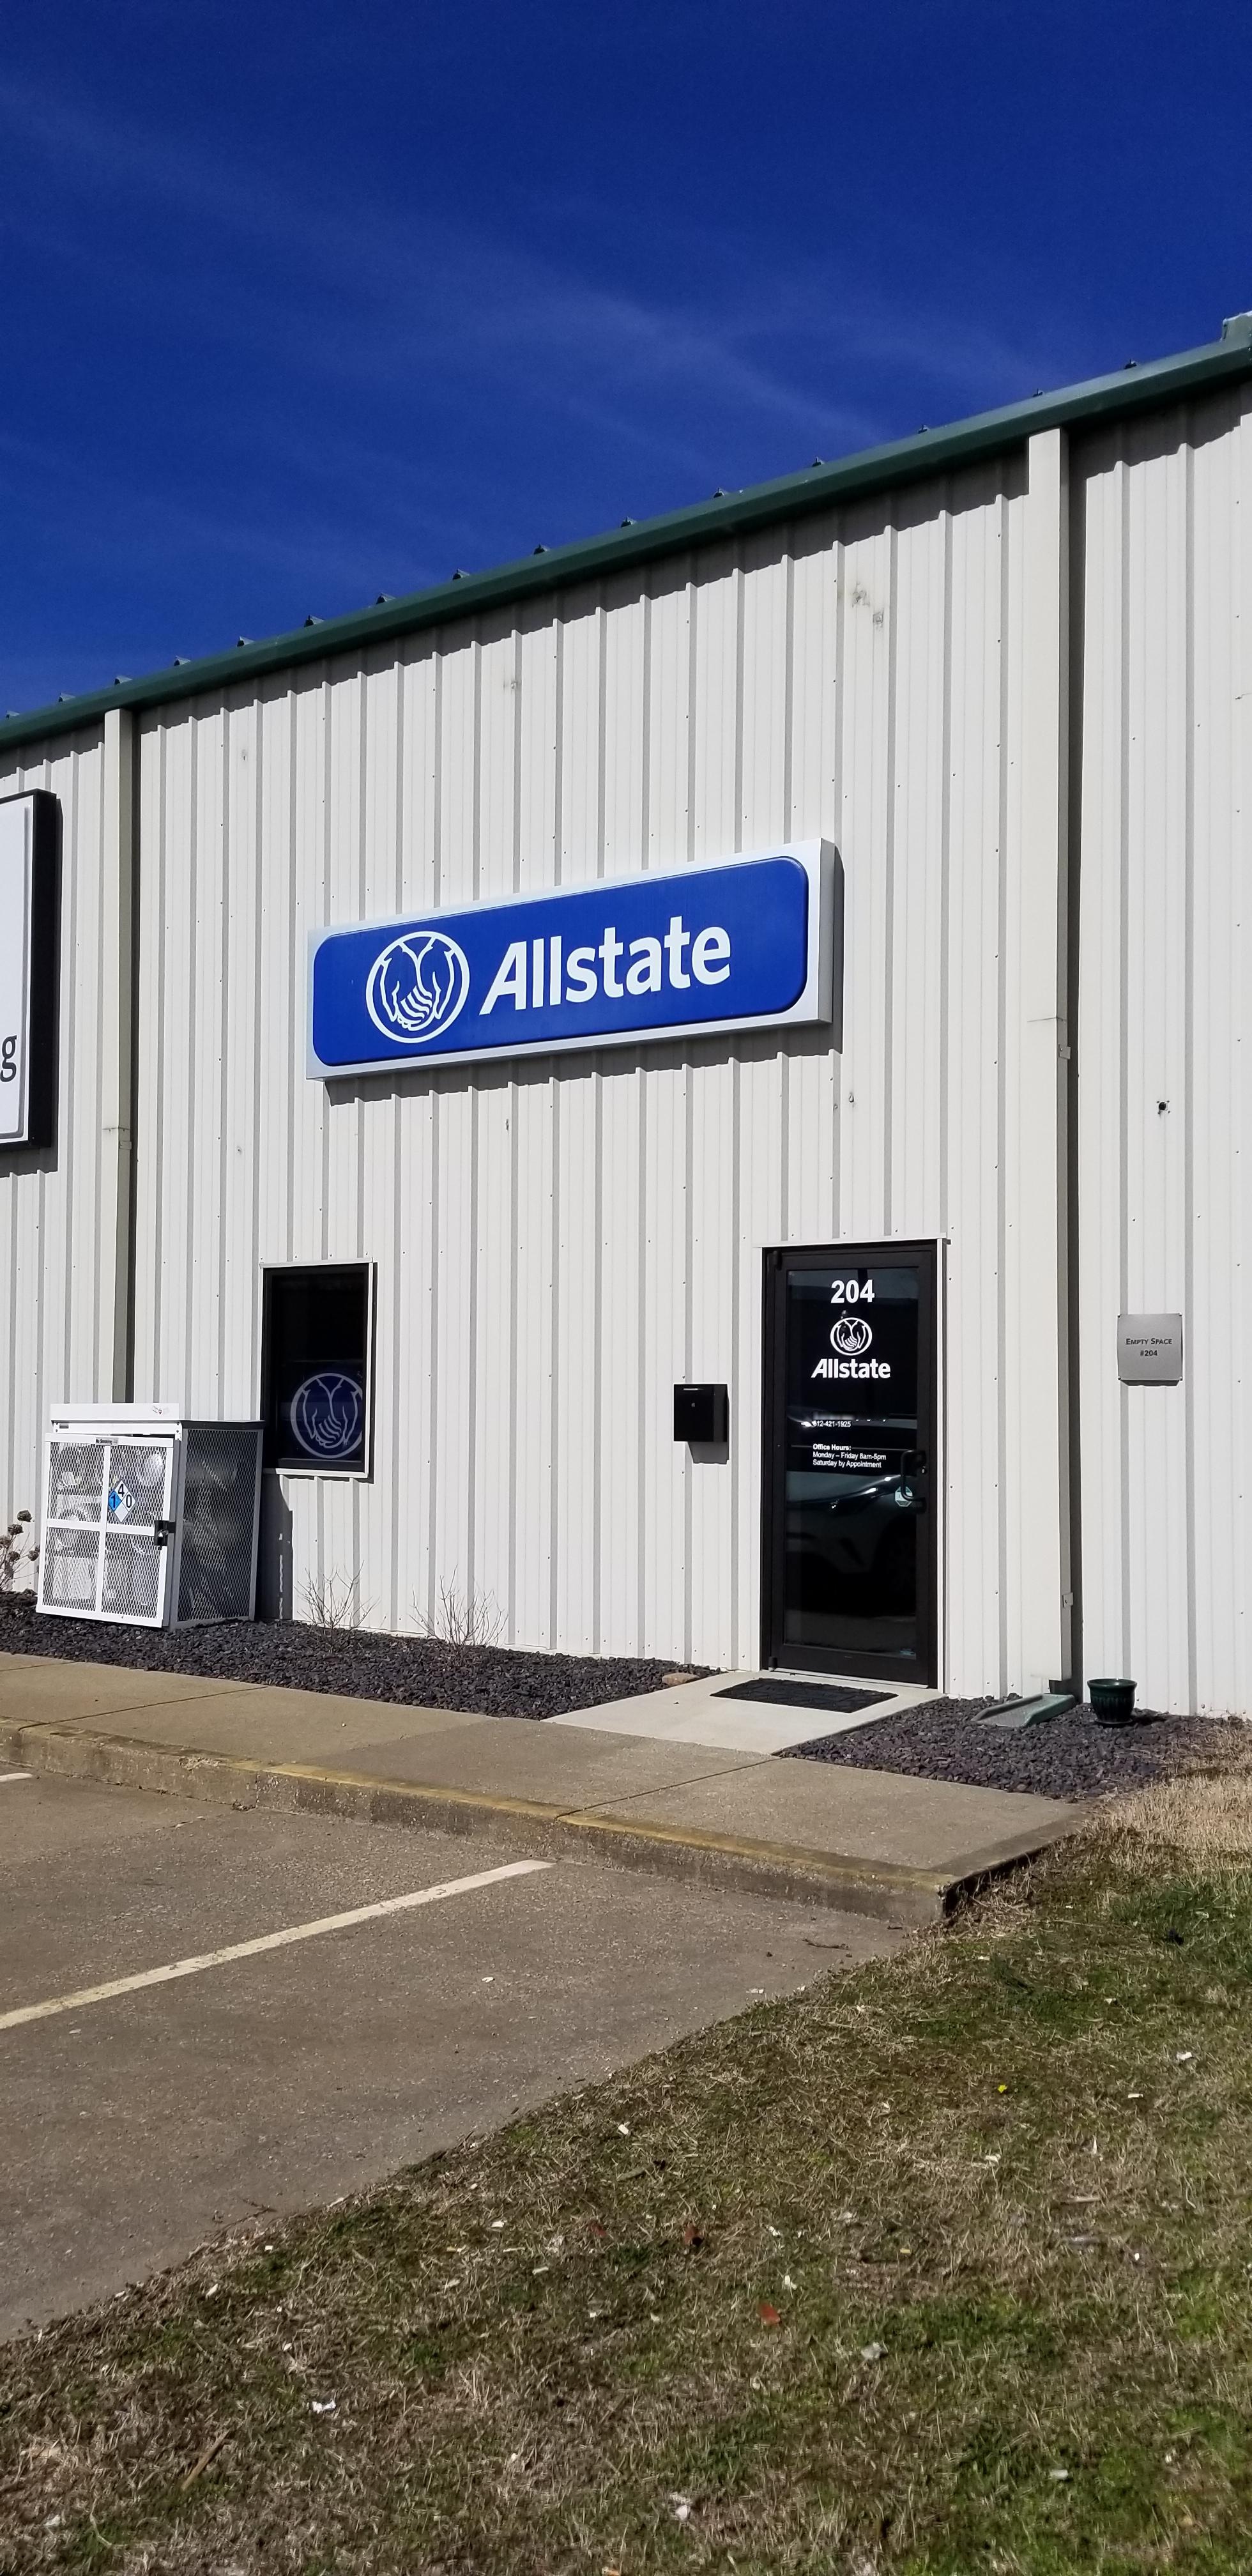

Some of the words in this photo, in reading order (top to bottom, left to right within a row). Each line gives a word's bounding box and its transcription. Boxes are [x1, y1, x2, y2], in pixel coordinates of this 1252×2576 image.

[478, 916, 731, 1015] Allstate
[830, 1280, 875, 1303] 204
[811, 1358, 891, 1379] Allstate
[813, 1451, 835, 1459] Monday
[841, 1452, 859, 1460] Friday
[859, 1452, 887, 1461] 8am-5pm
[813, 1459, 837, 1468] Saturday
[118, 1483, 125, 1497] 4
[111, 1494, 116, 1508] 1
[125, 1494, 132, 1508] 0
